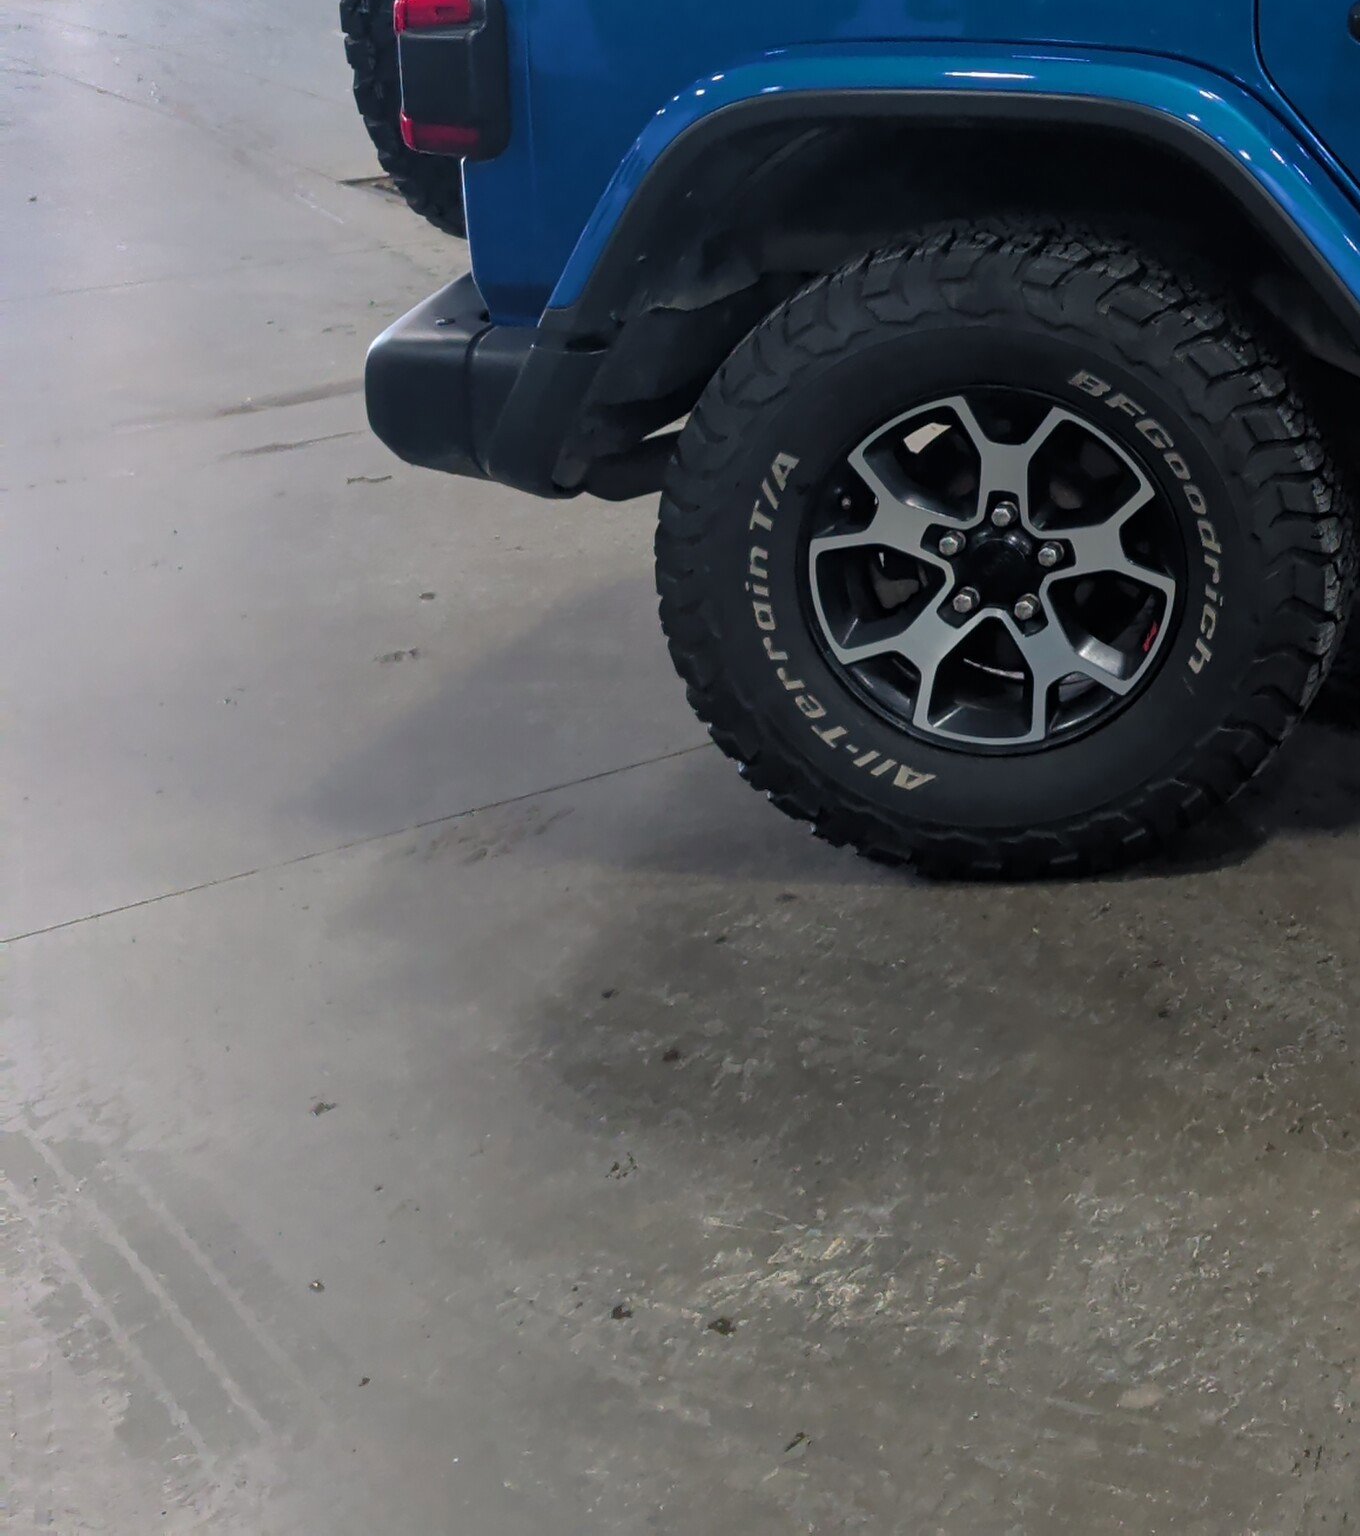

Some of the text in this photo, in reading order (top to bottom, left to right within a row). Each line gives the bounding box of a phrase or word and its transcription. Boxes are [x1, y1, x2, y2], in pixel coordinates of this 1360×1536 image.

[744, 451, 936, 791] All-Terrain T/A
[1067, 369, 1223, 674] BFGoodrich
